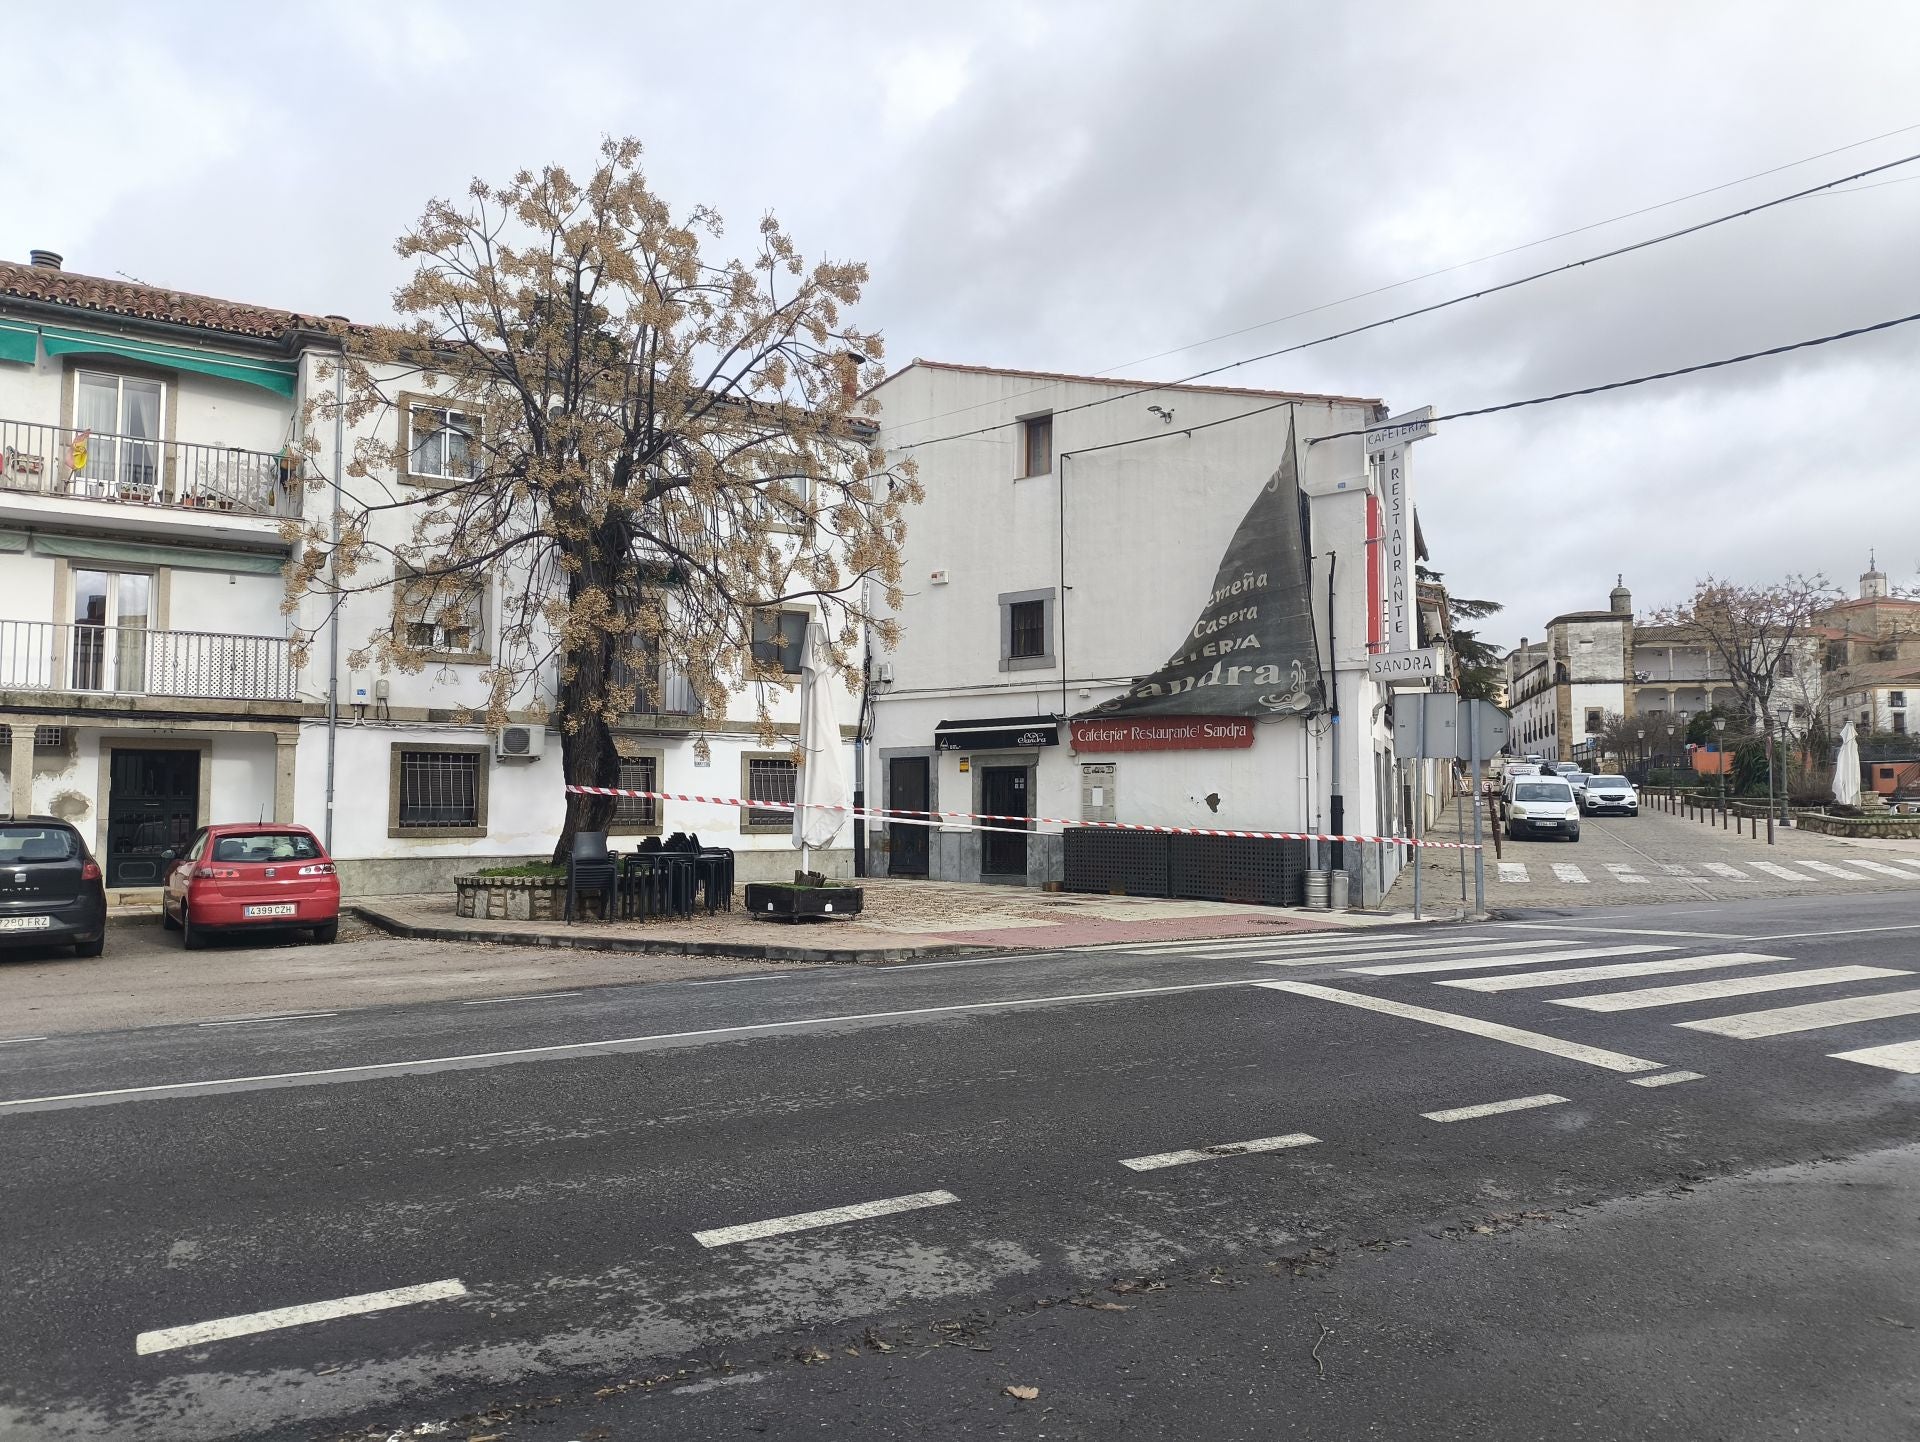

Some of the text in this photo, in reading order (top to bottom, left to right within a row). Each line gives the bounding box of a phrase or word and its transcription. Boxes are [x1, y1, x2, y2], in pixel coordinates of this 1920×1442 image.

[1391, 467, 1404, 633] RESTAURANTE
[1193, 605, 1258, 639] Casera
[1374, 655, 1432, 674] SANDRA
[1077, 722, 1247, 744] Cafetería Restaurante Sandra
[250, 905, 292, 915] 4399 CZH
[27, 917, 47, 927] FRZ
